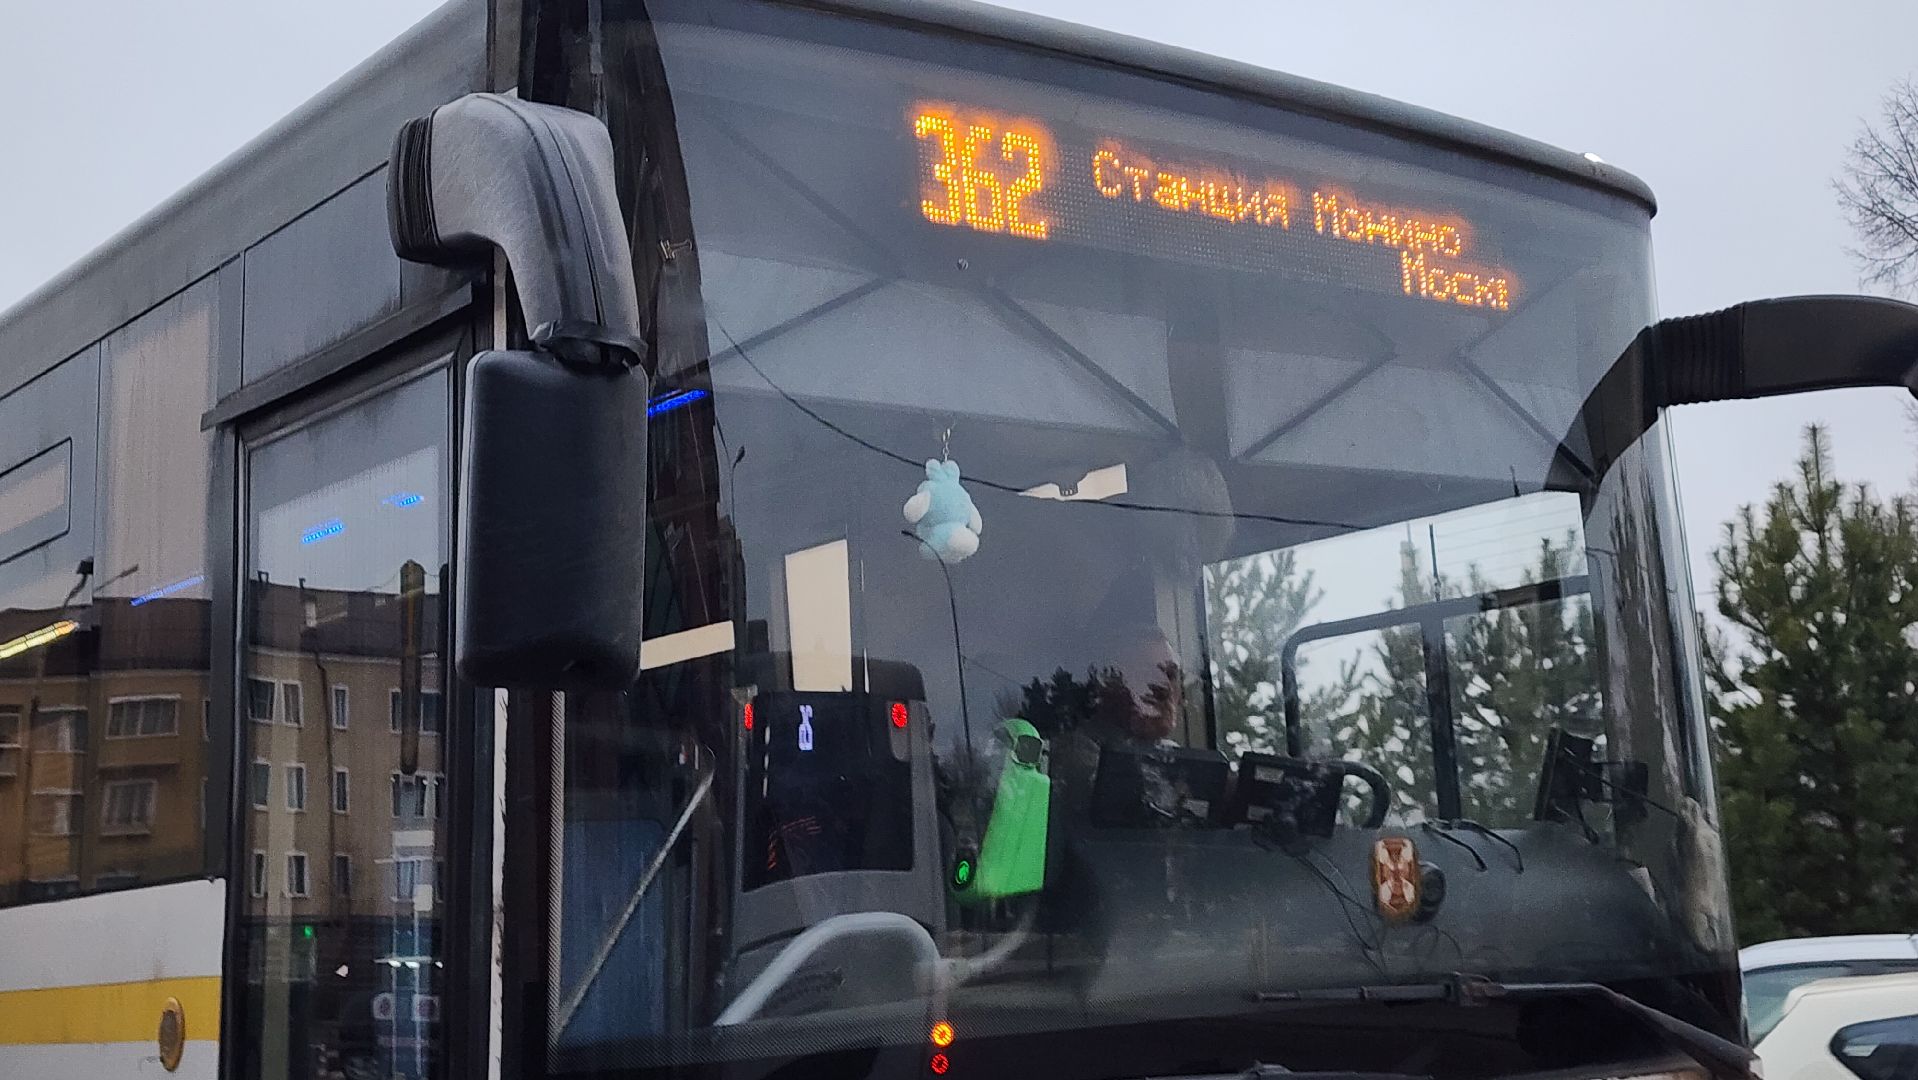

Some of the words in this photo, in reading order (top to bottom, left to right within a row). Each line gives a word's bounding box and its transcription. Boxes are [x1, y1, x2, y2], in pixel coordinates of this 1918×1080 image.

[914, 114, 1048, 238] 362
[1092, 149, 1290, 229] Станция
[1313, 191, 1461, 255] Монино
